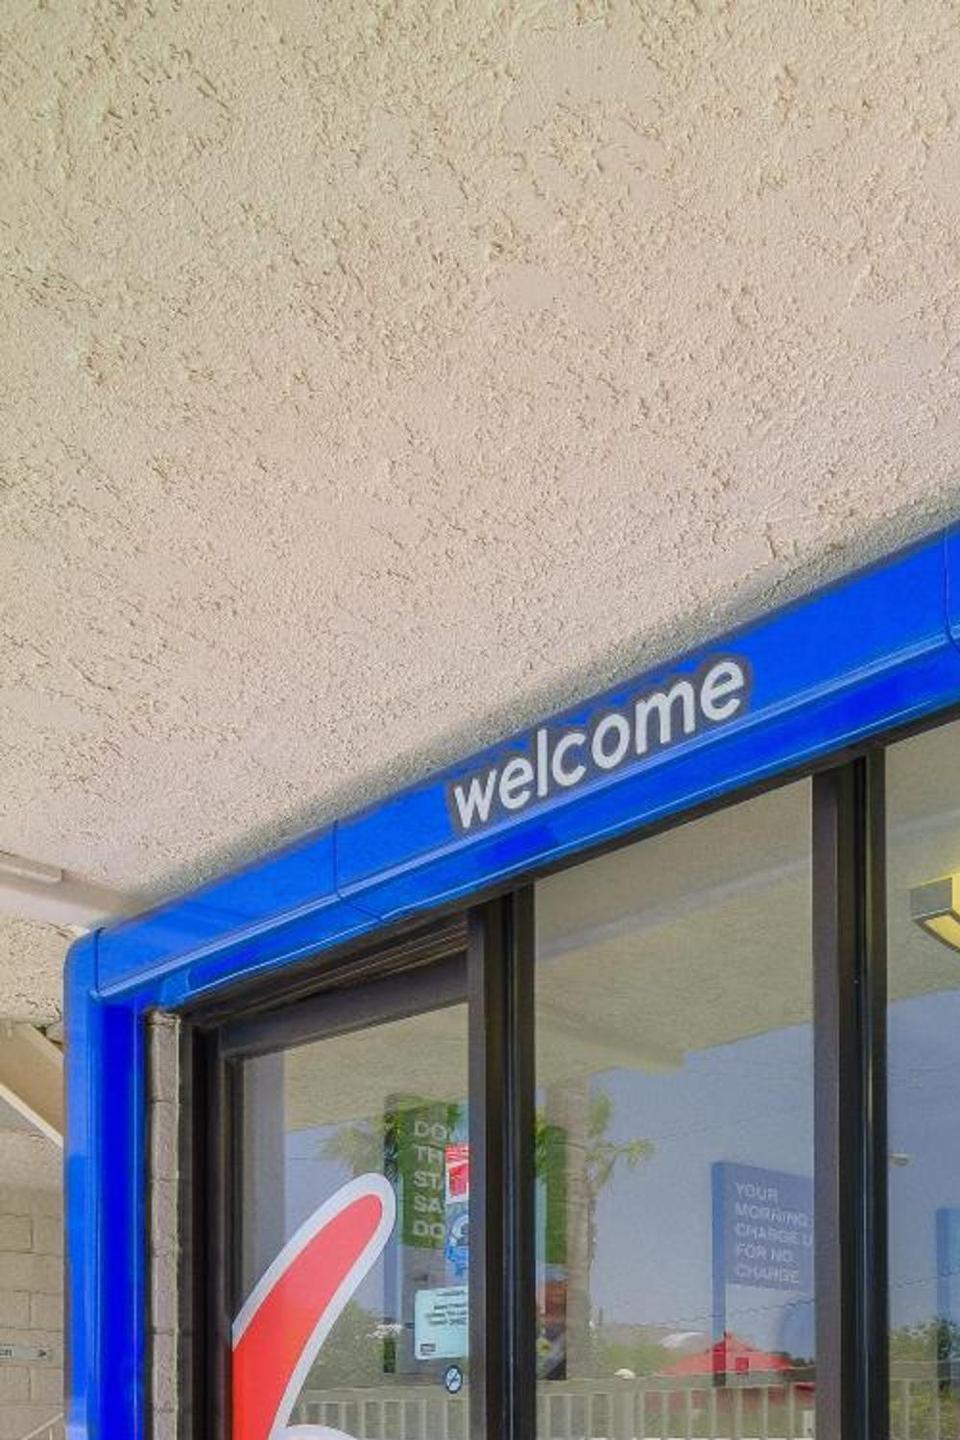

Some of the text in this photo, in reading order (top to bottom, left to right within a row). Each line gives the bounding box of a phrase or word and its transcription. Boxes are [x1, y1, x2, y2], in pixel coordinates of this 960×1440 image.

[454, 661, 744, 829] welcome
[735, 1182, 778, 1202] YOUR
[735, 1202, 808, 1228] MORNING
[736, 1242, 793, 1263] FOR NO
